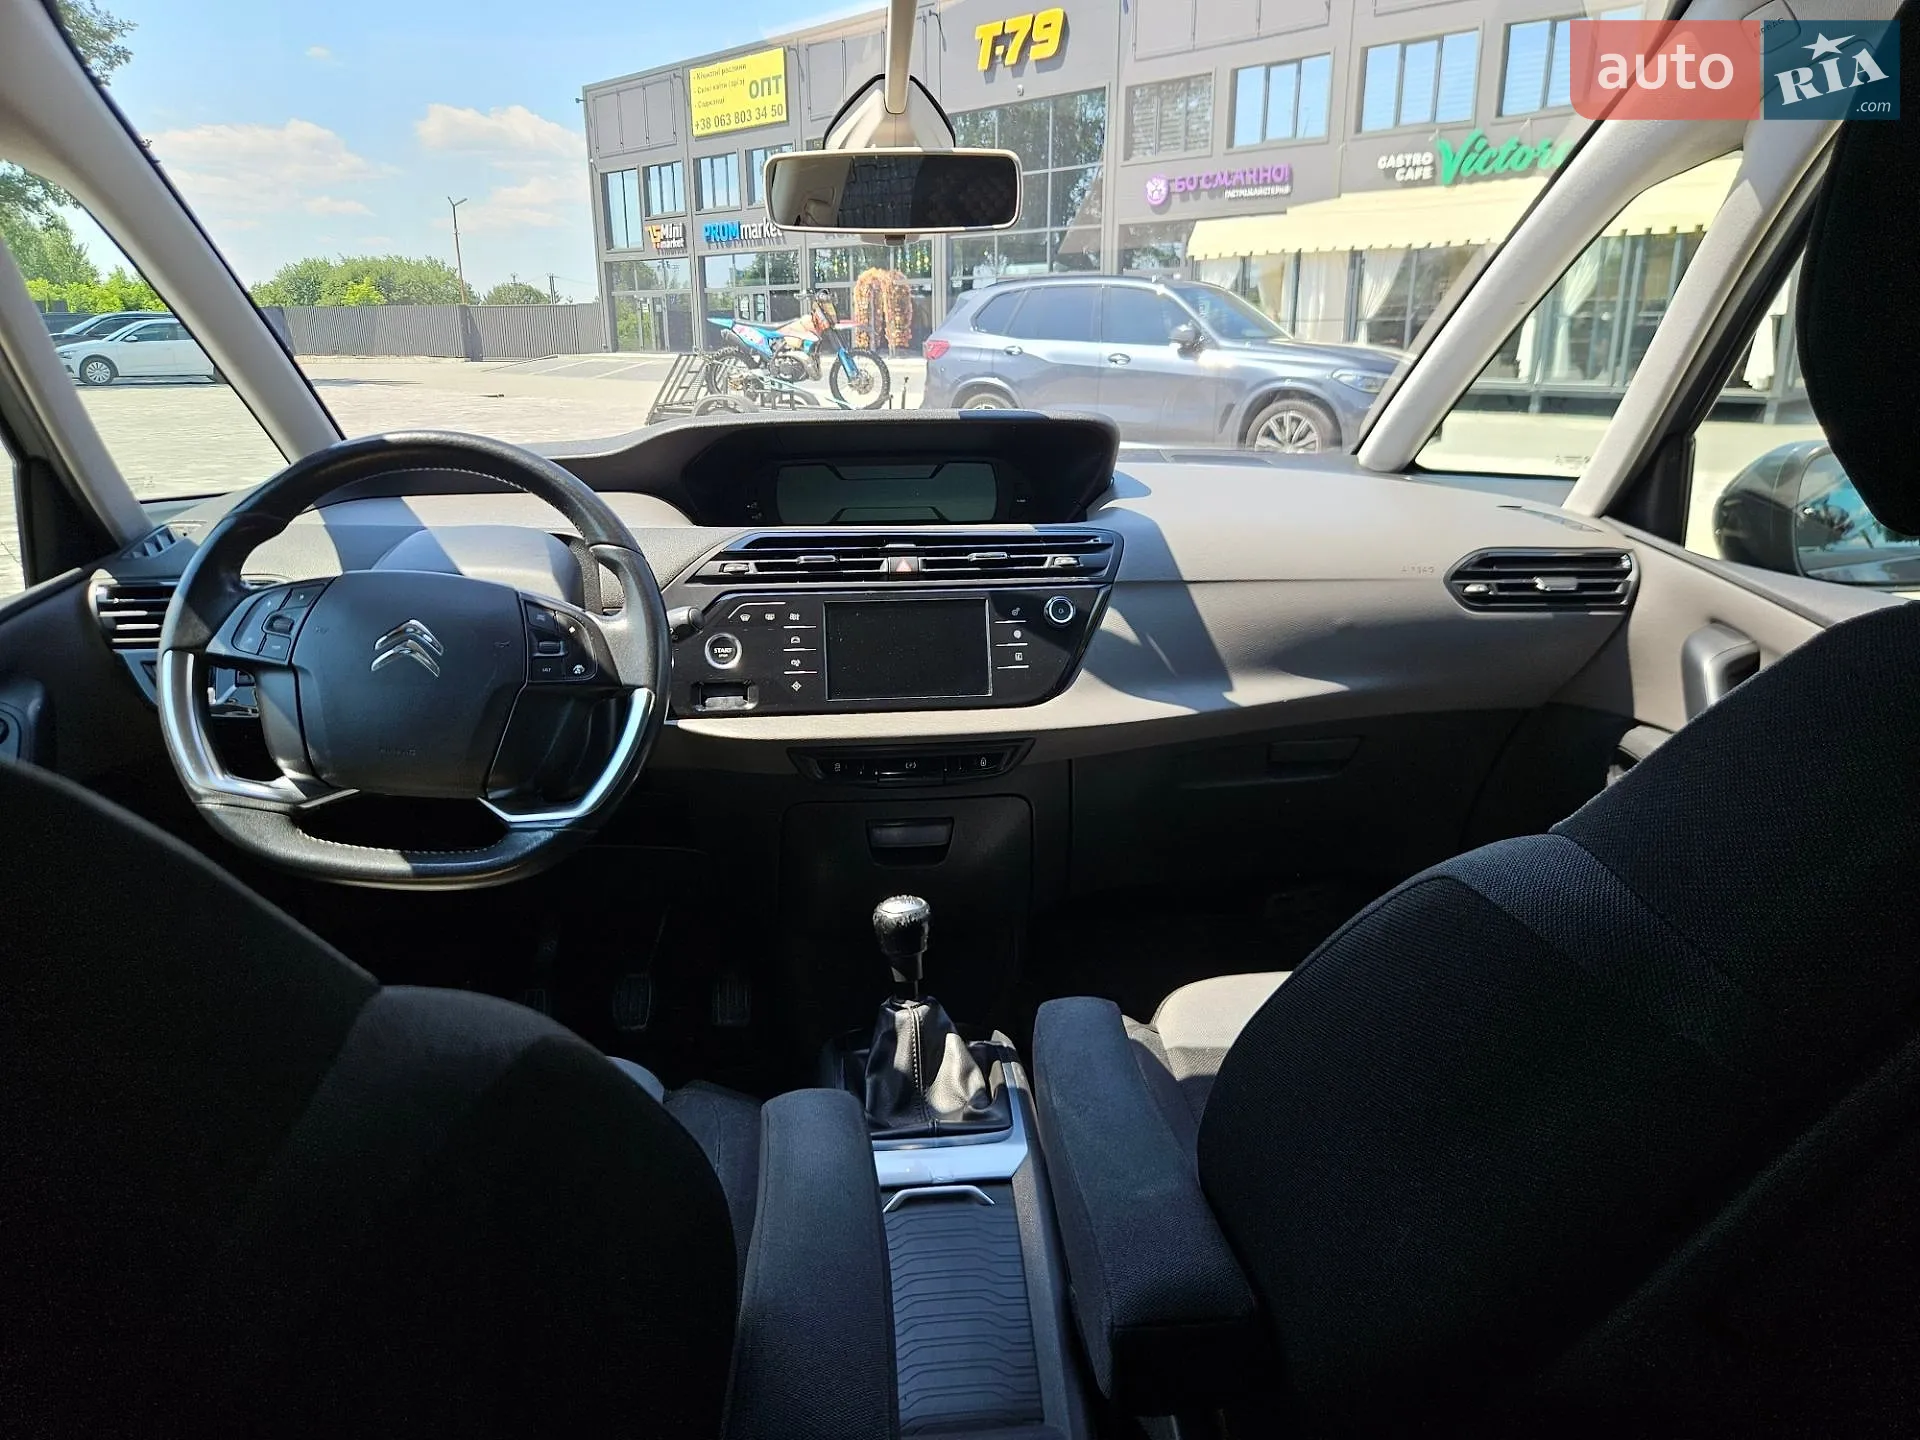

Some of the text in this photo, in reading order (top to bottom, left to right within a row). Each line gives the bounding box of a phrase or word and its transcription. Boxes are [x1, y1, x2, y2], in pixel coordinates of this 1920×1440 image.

[749, 75, 782, 99] ОПТ
[695, 103, 784, 130] +38 063 803 34 50
[1377, 152, 1434, 169] GASTRO
[1395, 166, 1434, 182] CAFE
